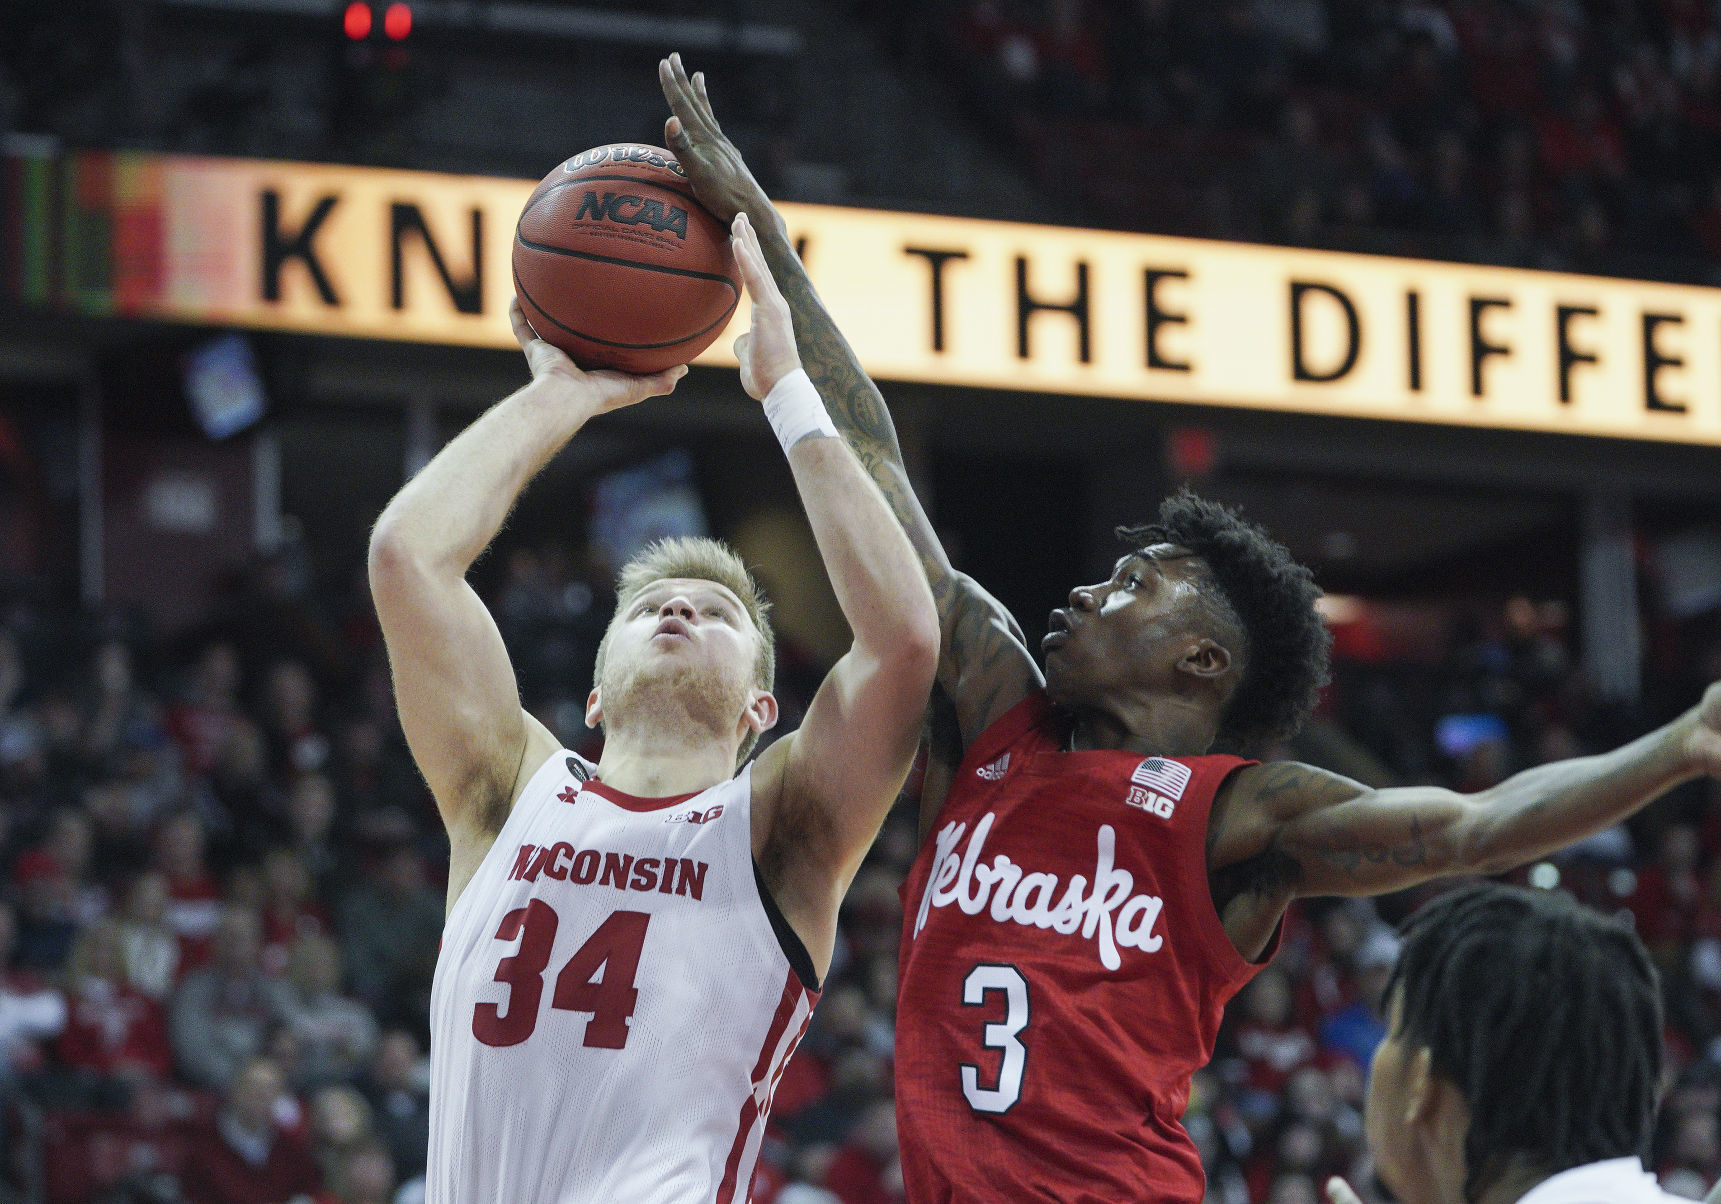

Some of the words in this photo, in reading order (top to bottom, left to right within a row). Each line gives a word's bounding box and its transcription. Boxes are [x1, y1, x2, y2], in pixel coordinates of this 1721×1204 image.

[565, 146, 688, 178] Wilso
[575, 191, 689, 241] NCAA
[902, 243, 1193, 373] THE
[1288, 278, 1688, 414] DIFFE
[507, 841, 709, 902] WICONSIN
[912, 811, 1164, 972] Nebraska
[472, 897, 652, 1050] 34
[958, 962, 1031, 1117] 3
